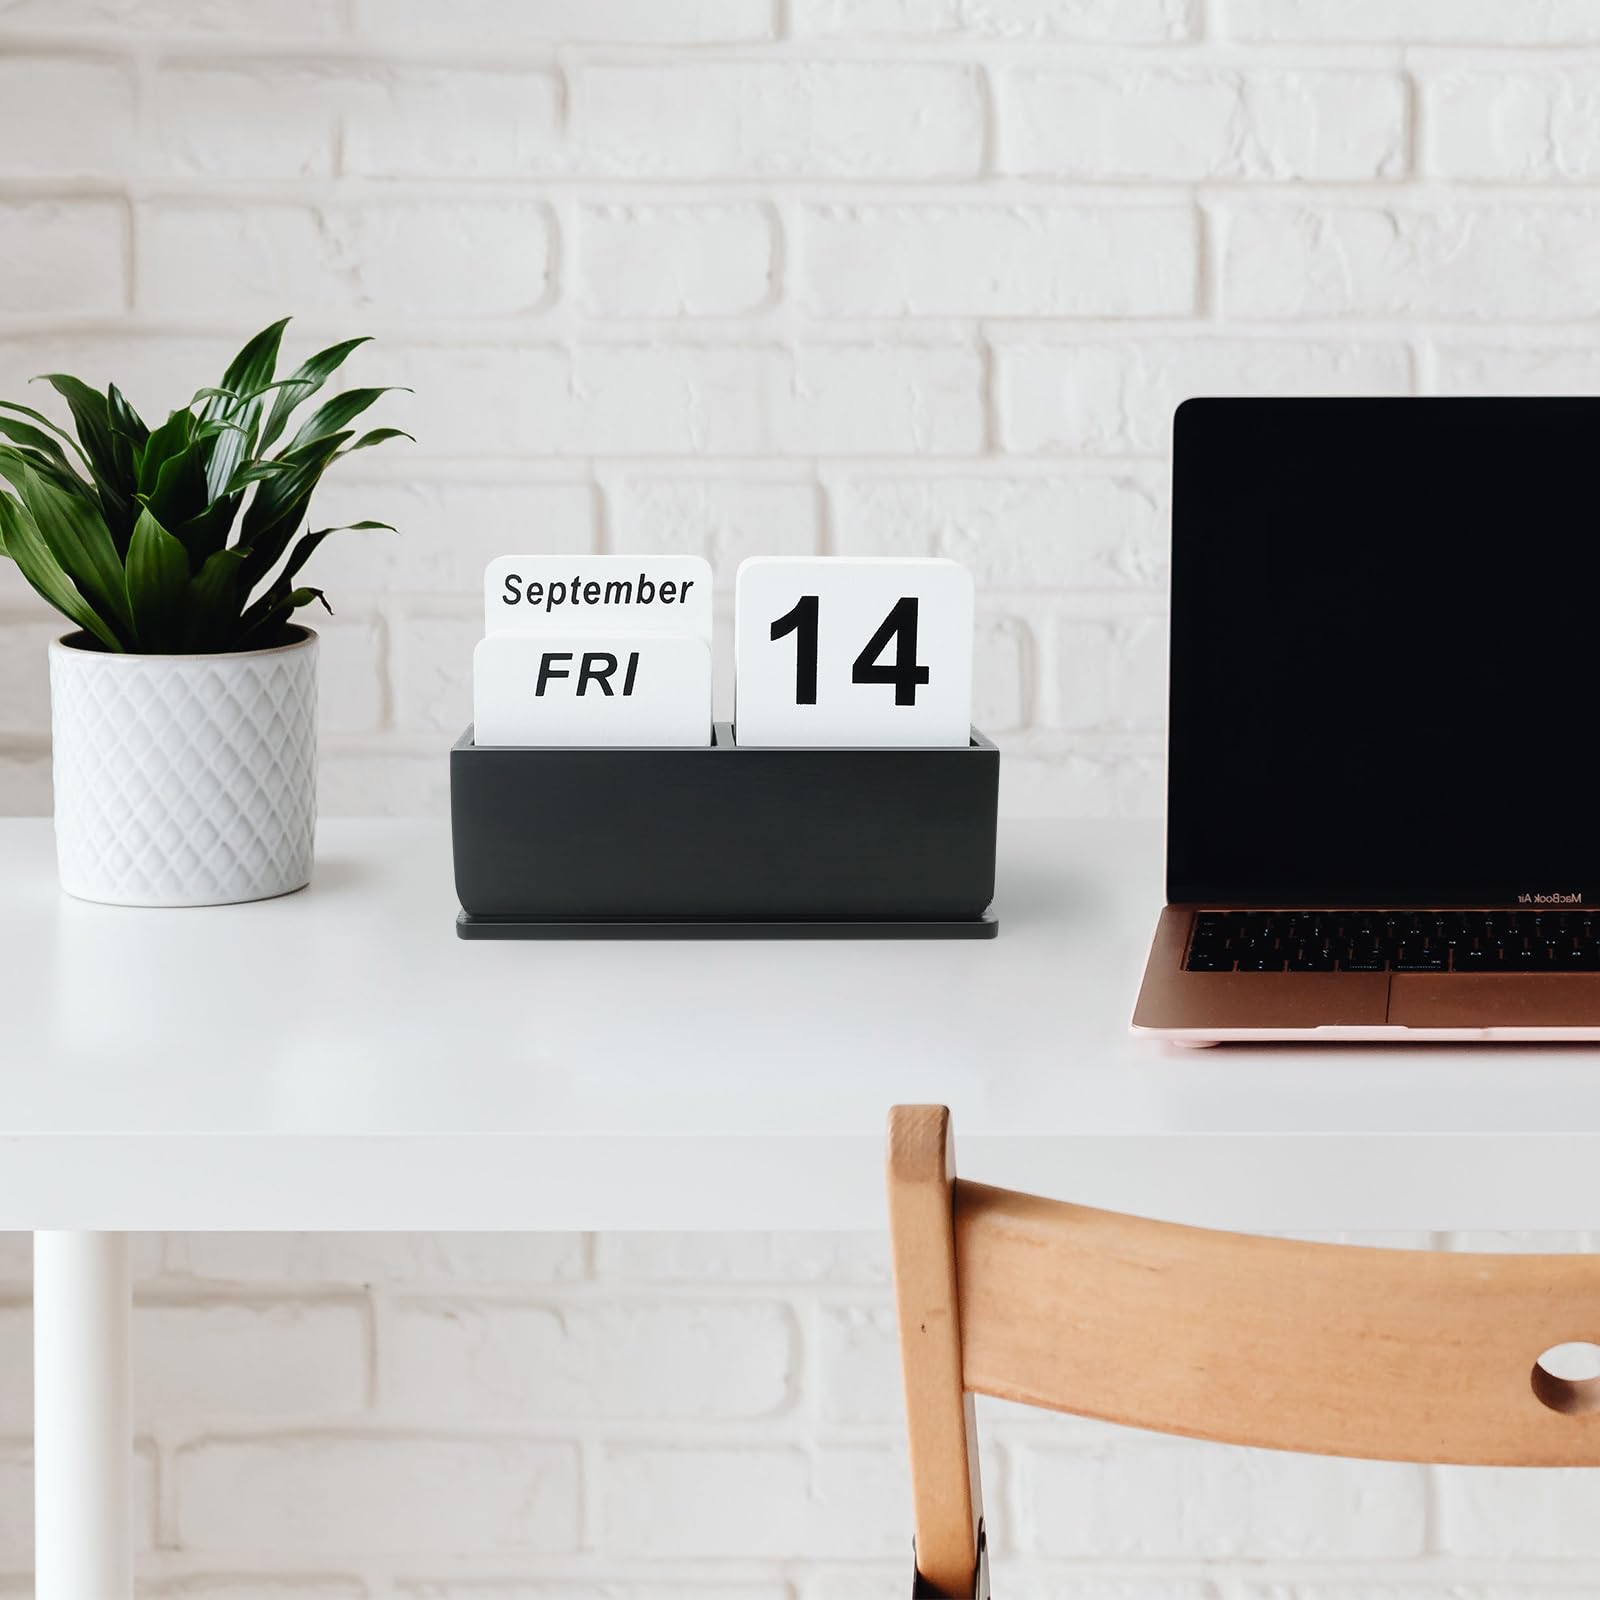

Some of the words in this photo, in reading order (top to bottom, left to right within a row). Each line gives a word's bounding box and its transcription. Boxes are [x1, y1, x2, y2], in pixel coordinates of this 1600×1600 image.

[502, 573, 695, 613] September
[534, 651, 640, 697] FRI
[770, 595, 930, 707] 14
